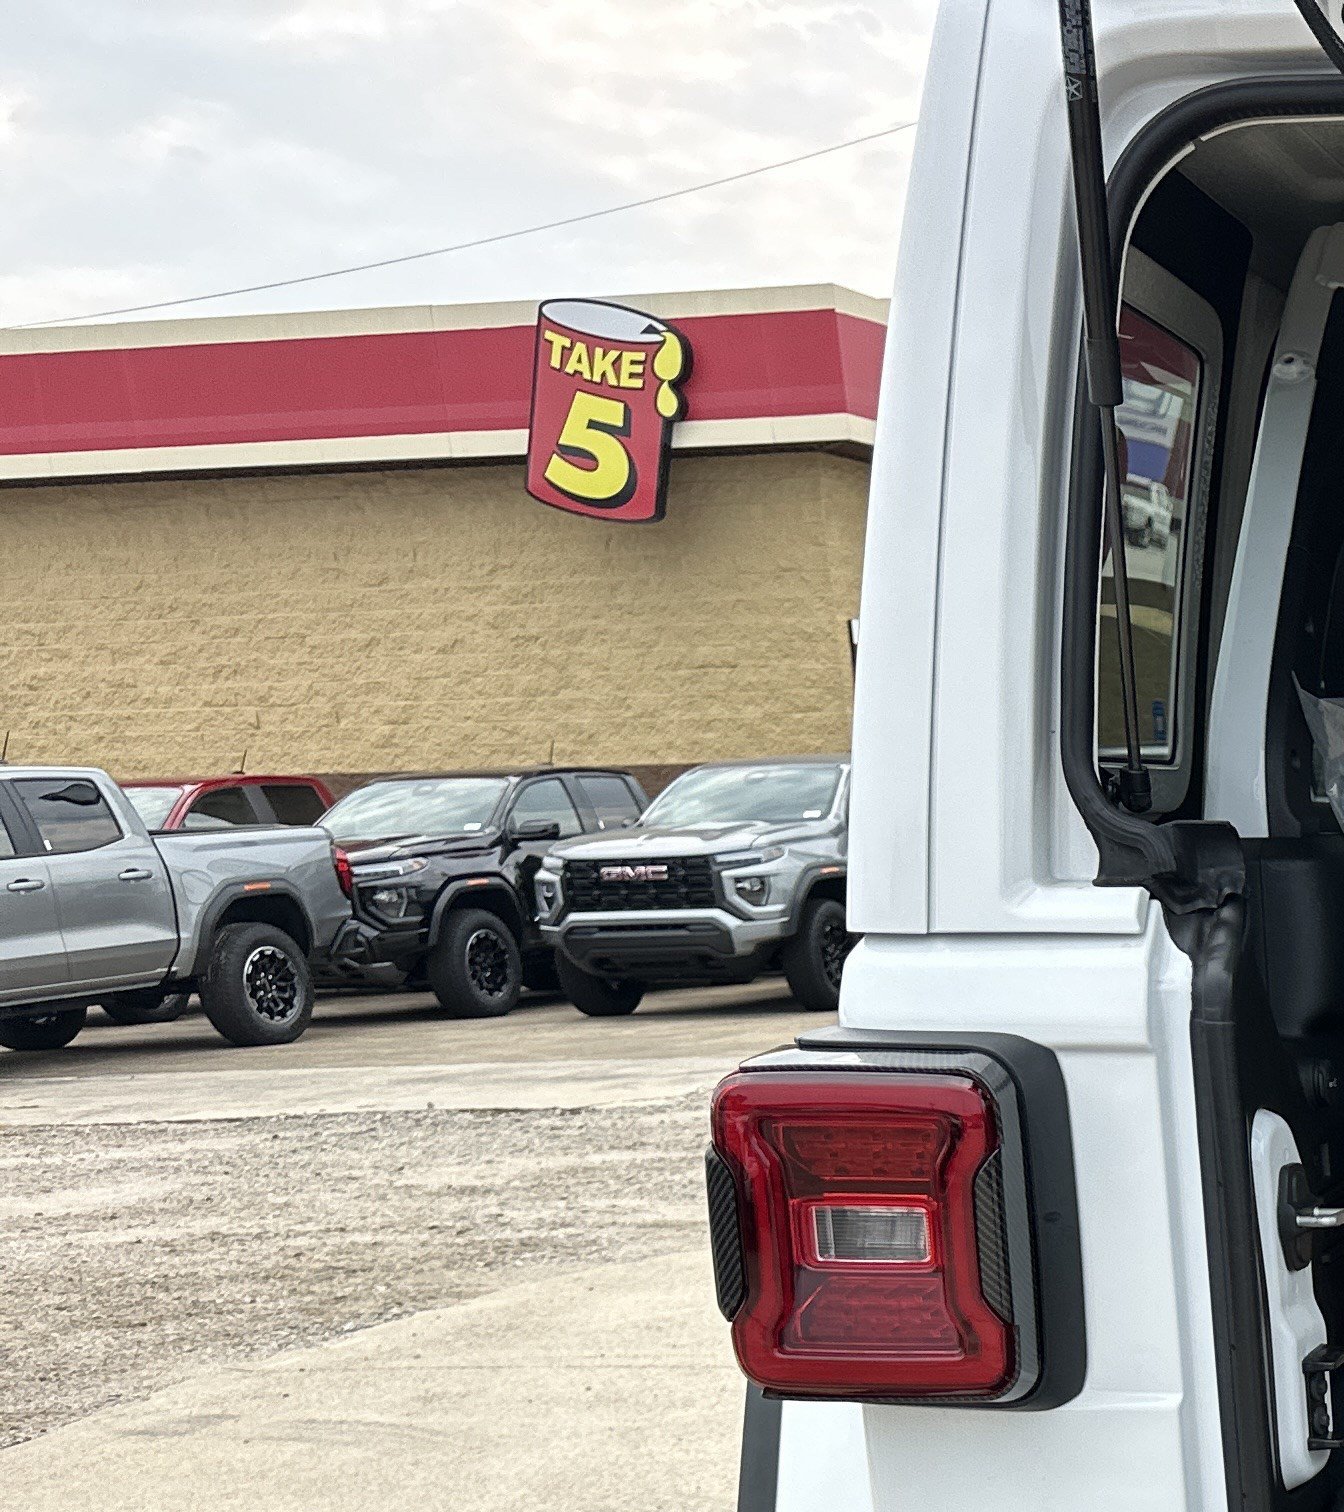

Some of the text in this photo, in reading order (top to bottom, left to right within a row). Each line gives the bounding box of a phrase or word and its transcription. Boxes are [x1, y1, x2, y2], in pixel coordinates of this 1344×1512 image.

[544, 330, 646, 389] TAKE
[544, 391, 633, 503] 5
[601, 864, 668, 881] GMC
